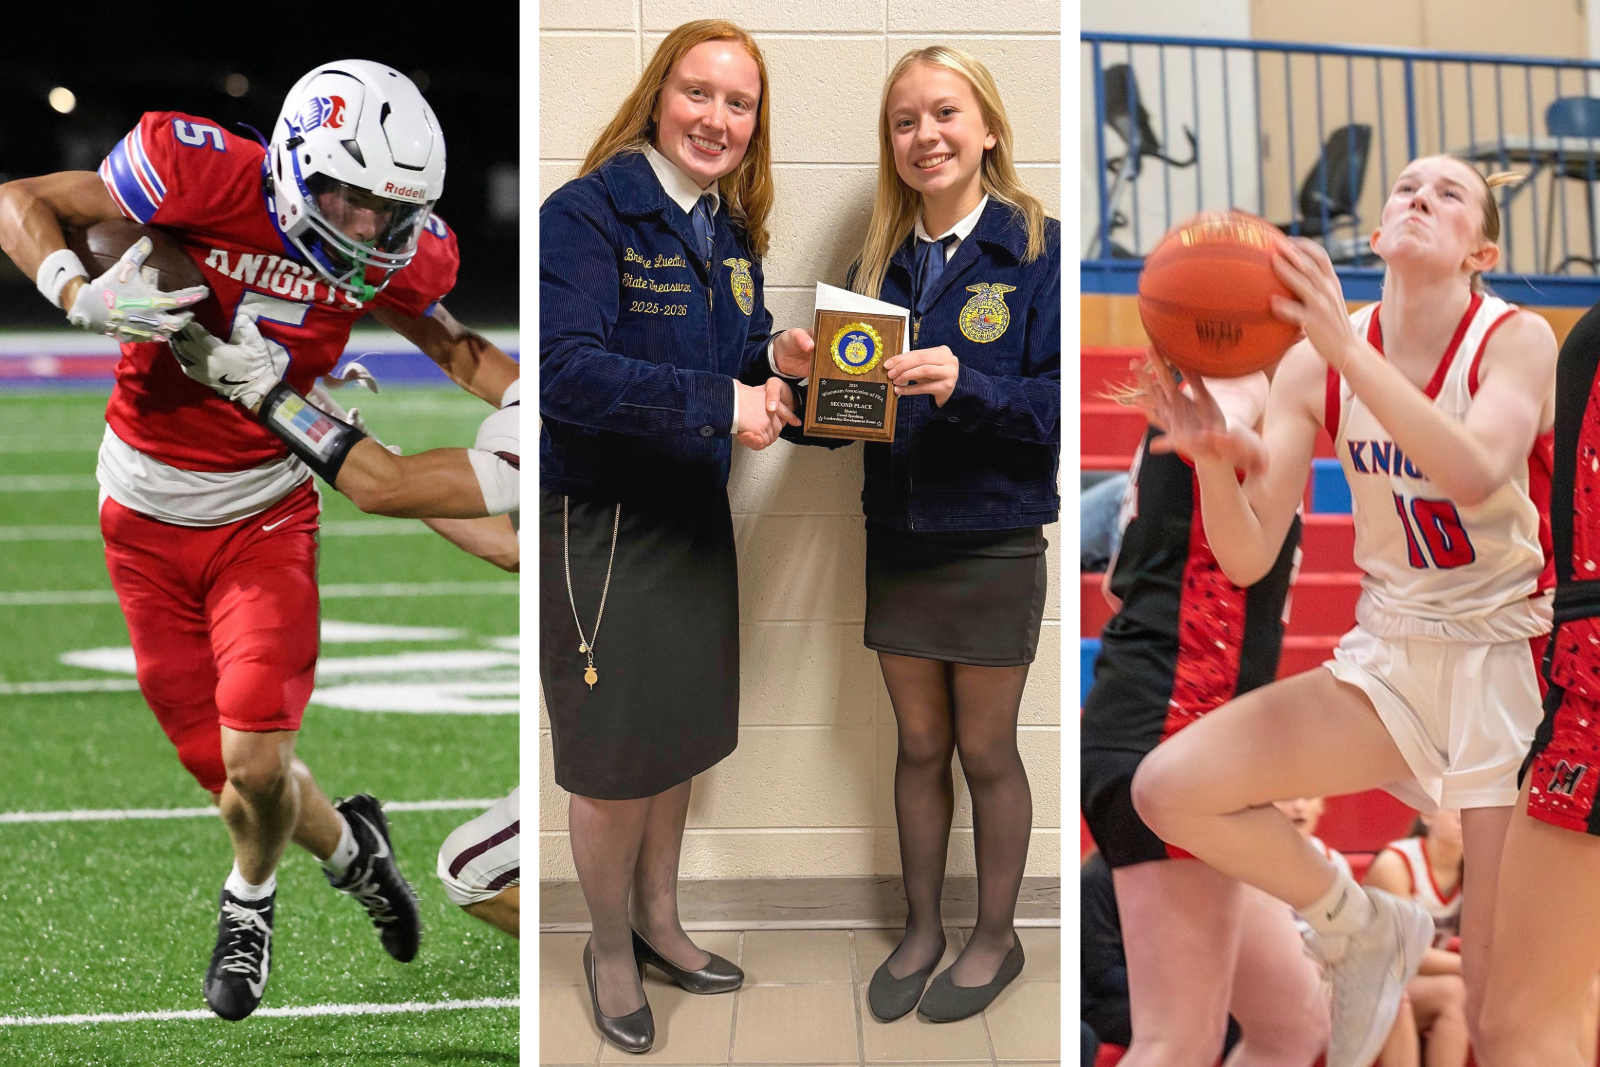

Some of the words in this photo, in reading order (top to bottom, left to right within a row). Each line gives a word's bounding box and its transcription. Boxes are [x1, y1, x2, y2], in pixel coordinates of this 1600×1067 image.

[171, 118, 226, 153] 5
[384, 182, 426, 199] Riddell
[622, 273, 649, 289] State
[629, 301, 688, 316] 2025-2026
[1392, 490, 1476, 569] 10
